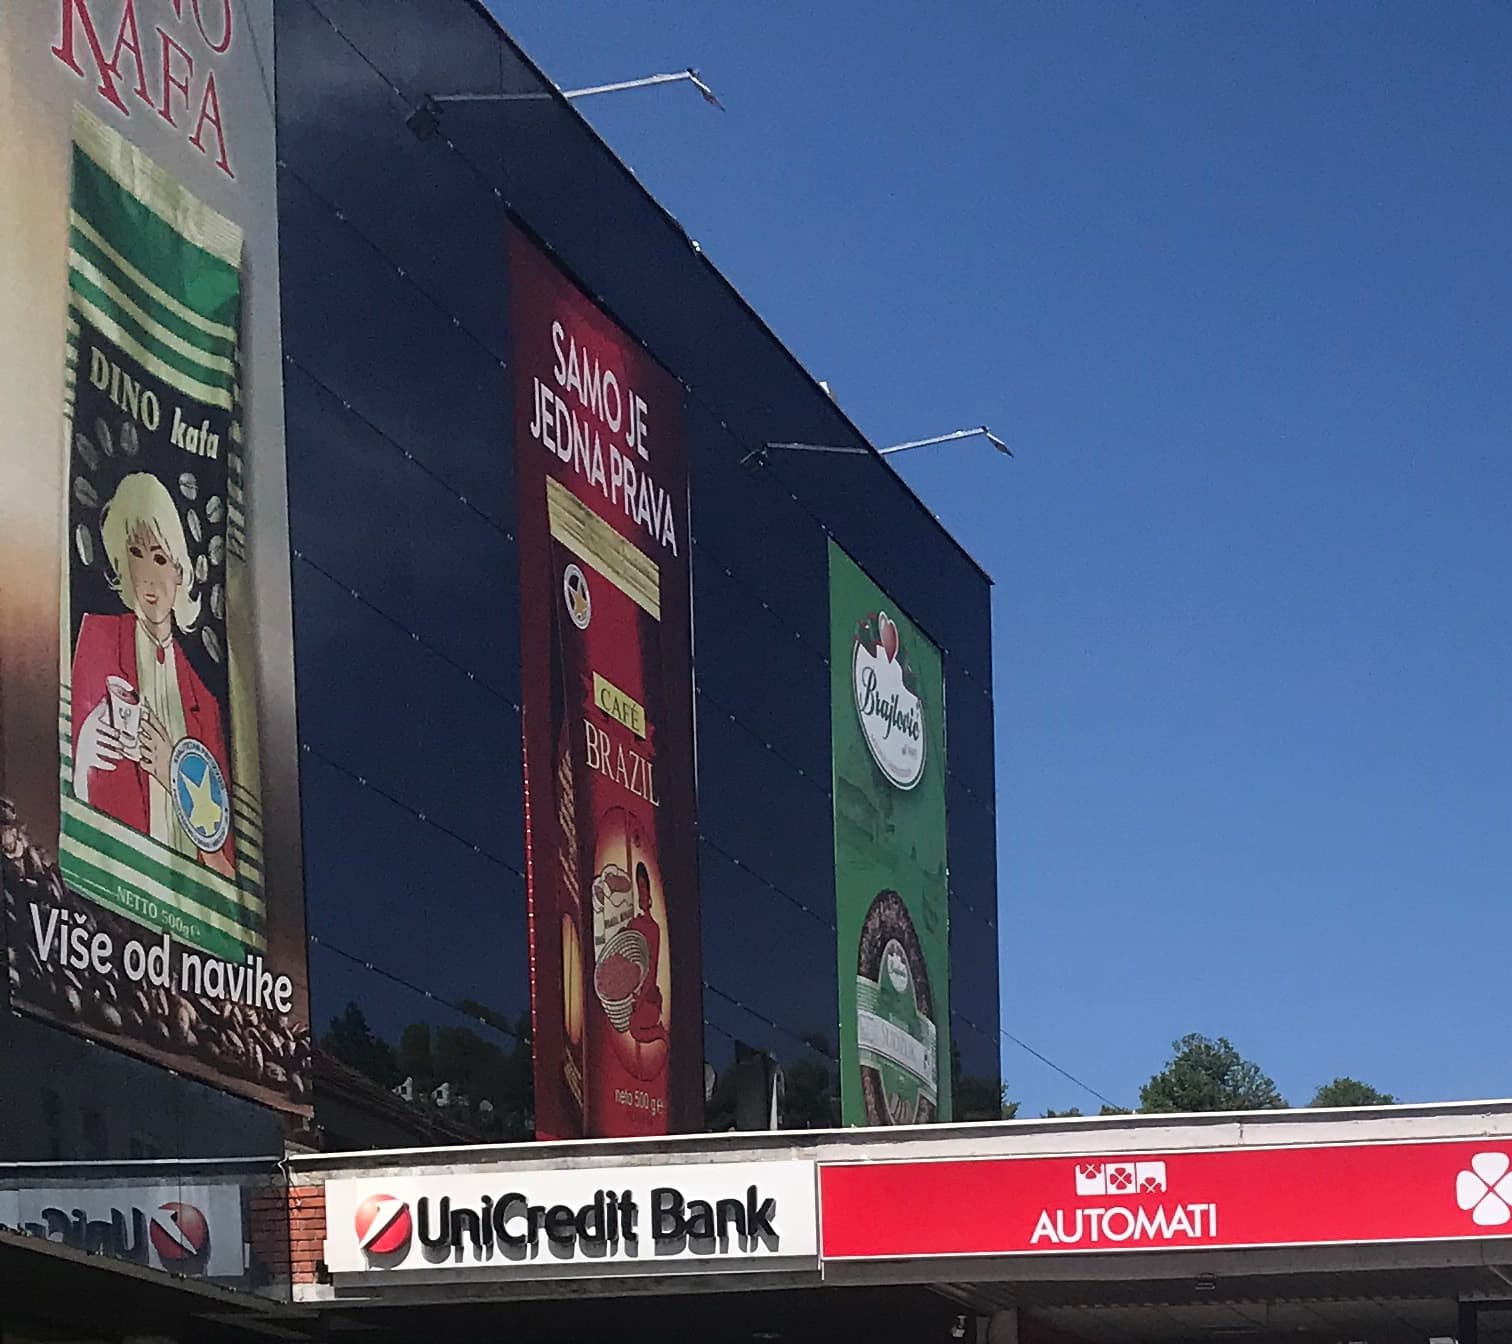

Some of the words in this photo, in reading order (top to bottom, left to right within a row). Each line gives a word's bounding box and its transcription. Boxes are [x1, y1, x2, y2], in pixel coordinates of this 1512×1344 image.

[89, 346, 160, 431] DINO
[170, 407, 219, 460] kafa
[552, 321, 621, 433] SAMO
[626, 389, 649, 462] JE
[530, 377, 608, 497] JEDNA
[610, 444, 677, 557] PRAVA
[600, 688, 639, 731] CAFÉ
[584, 719, 660, 807] BRAZIL
[116, 886, 158, 919] NETTO
[30, 903, 113, 973] Više
[124, 934, 170, 987] od
[182, 952, 293, 1013] navike
[418, 1189, 638, 1248] UniCredit
[651, 1186, 776, 1240] Bank
[1030, 1202, 1217, 1244] AUTOMATI
